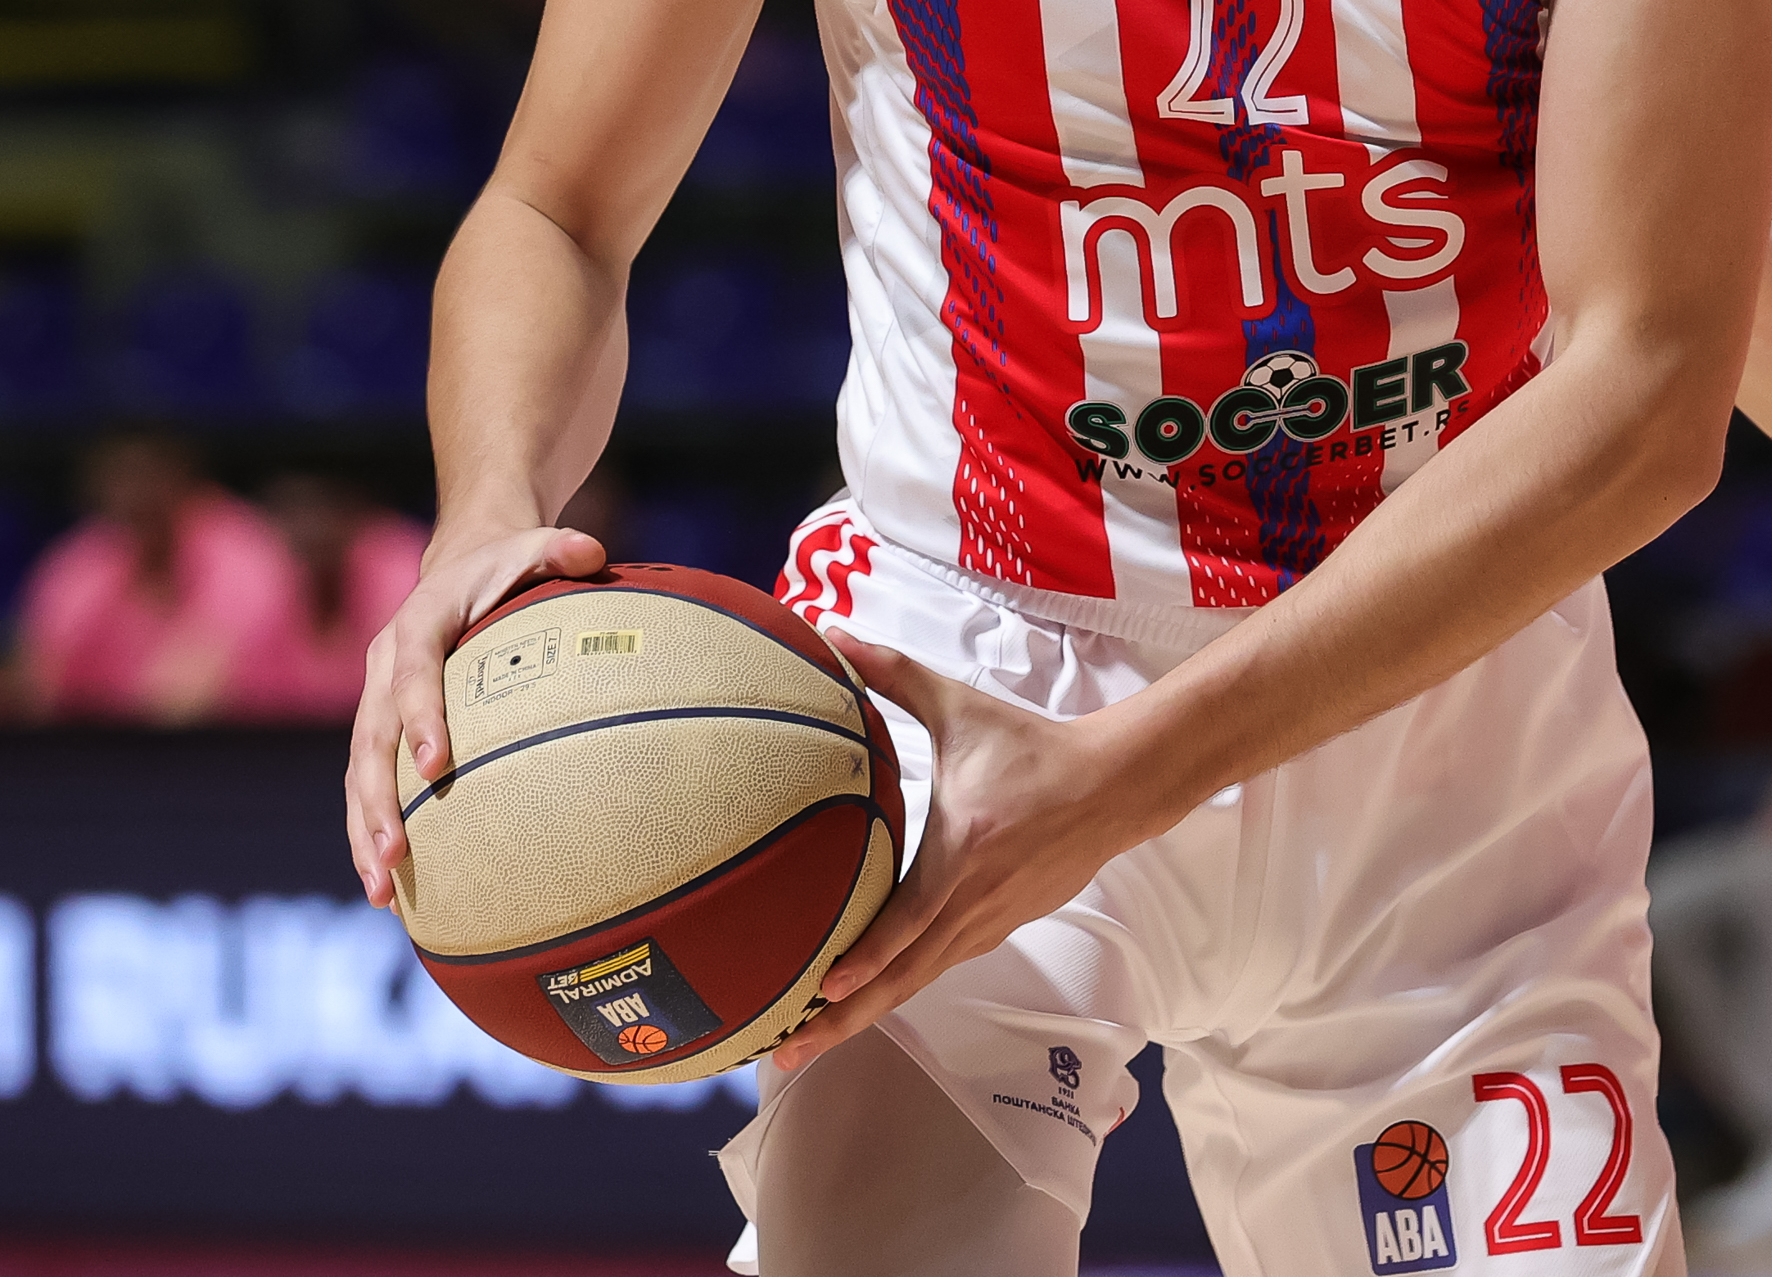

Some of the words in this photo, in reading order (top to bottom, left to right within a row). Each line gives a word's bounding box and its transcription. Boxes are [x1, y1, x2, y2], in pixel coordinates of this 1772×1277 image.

[1060, 149, 1465, 322] mts
[1065, 339, 1472, 466] SOCCER
[546, 643, 558, 665] SIZE
[482, 689, 513, 707] INDOOR
[547, 970, 579, 990] BET
[549, 957, 652, 1004] ADMIRAL
[596, 992, 650, 1028] ABA
[992, 1093, 1066, 1122] ПОШТАНСКА
[1471, 1064, 1643, 1256] 22
[1375, 1205, 1450, 1265] ABA
